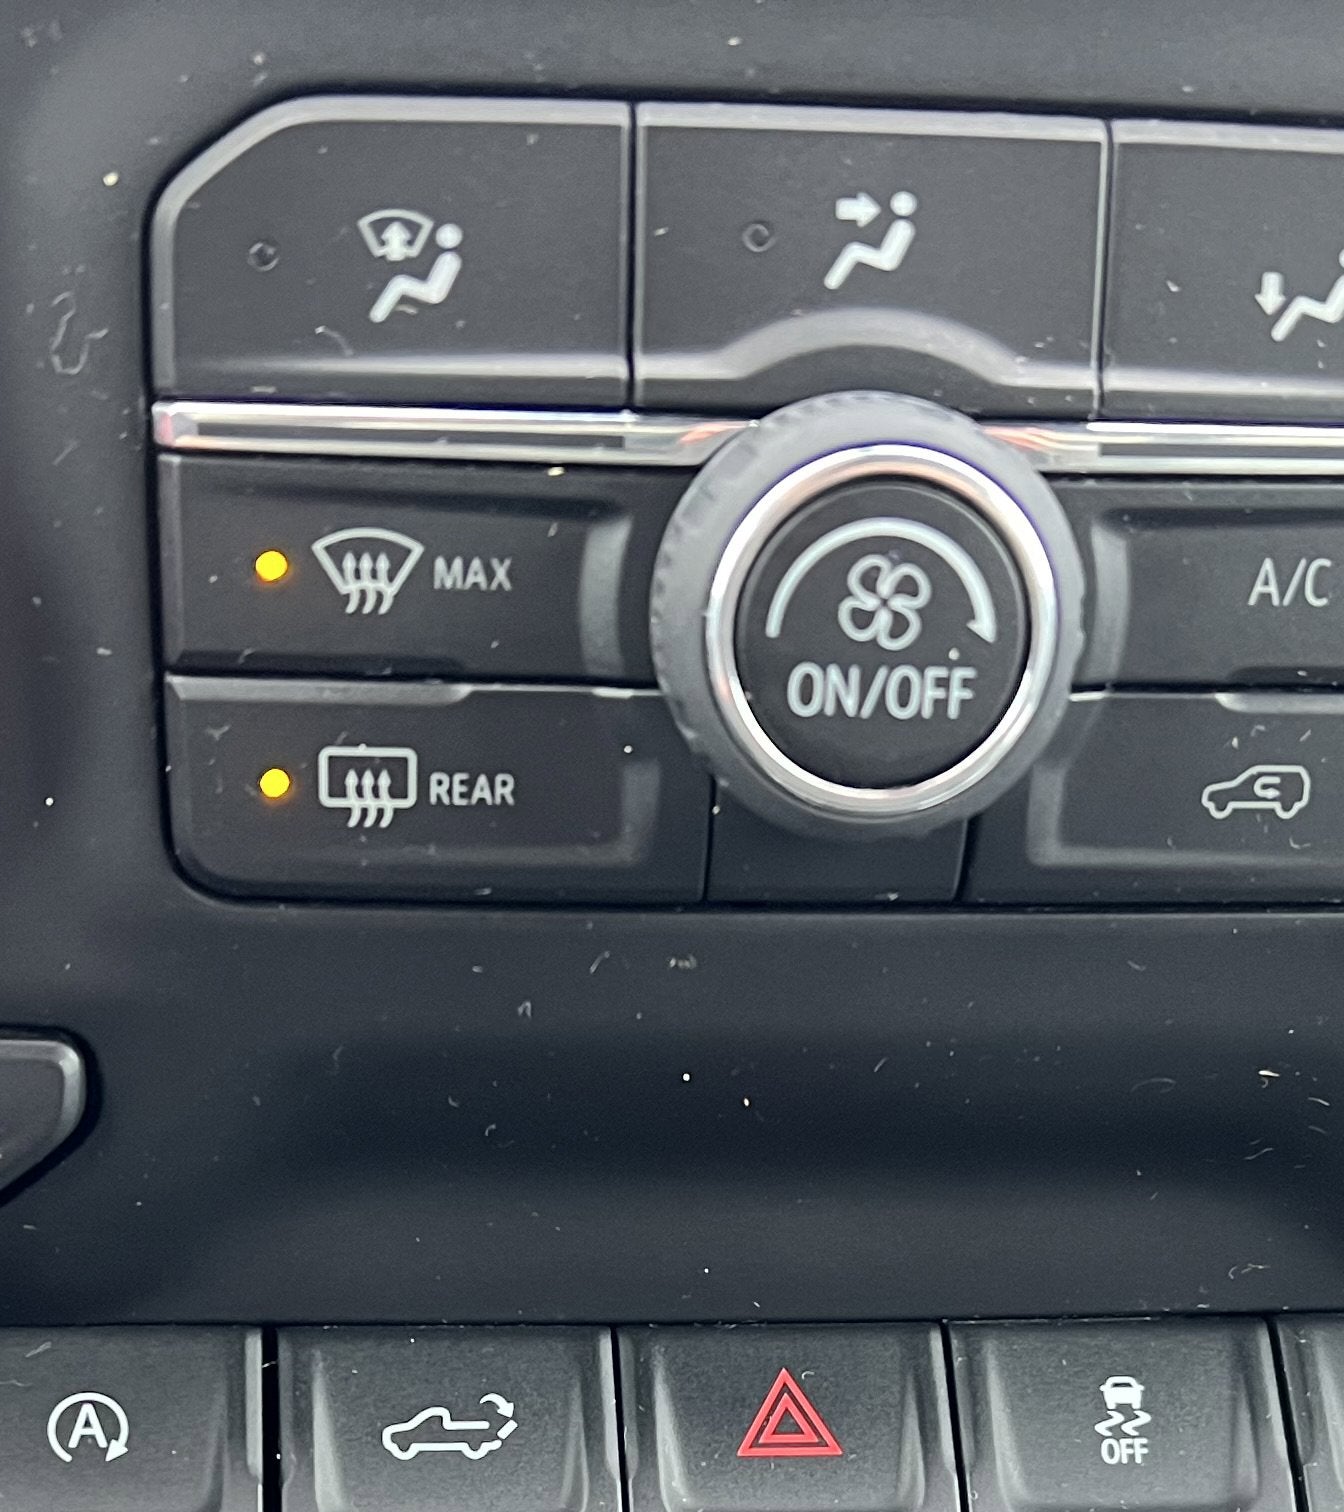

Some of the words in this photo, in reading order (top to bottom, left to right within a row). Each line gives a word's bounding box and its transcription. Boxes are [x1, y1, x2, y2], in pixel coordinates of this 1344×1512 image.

[432, 555, 514, 592] MAX
[1246, 556, 1333, 608] A/C
[786, 661, 978, 721] ON/OFF
[429, 771, 516, 807] REAR
[67, 1402, 108, 1449] A
[1100, 1437, 1150, 1465] OFF
